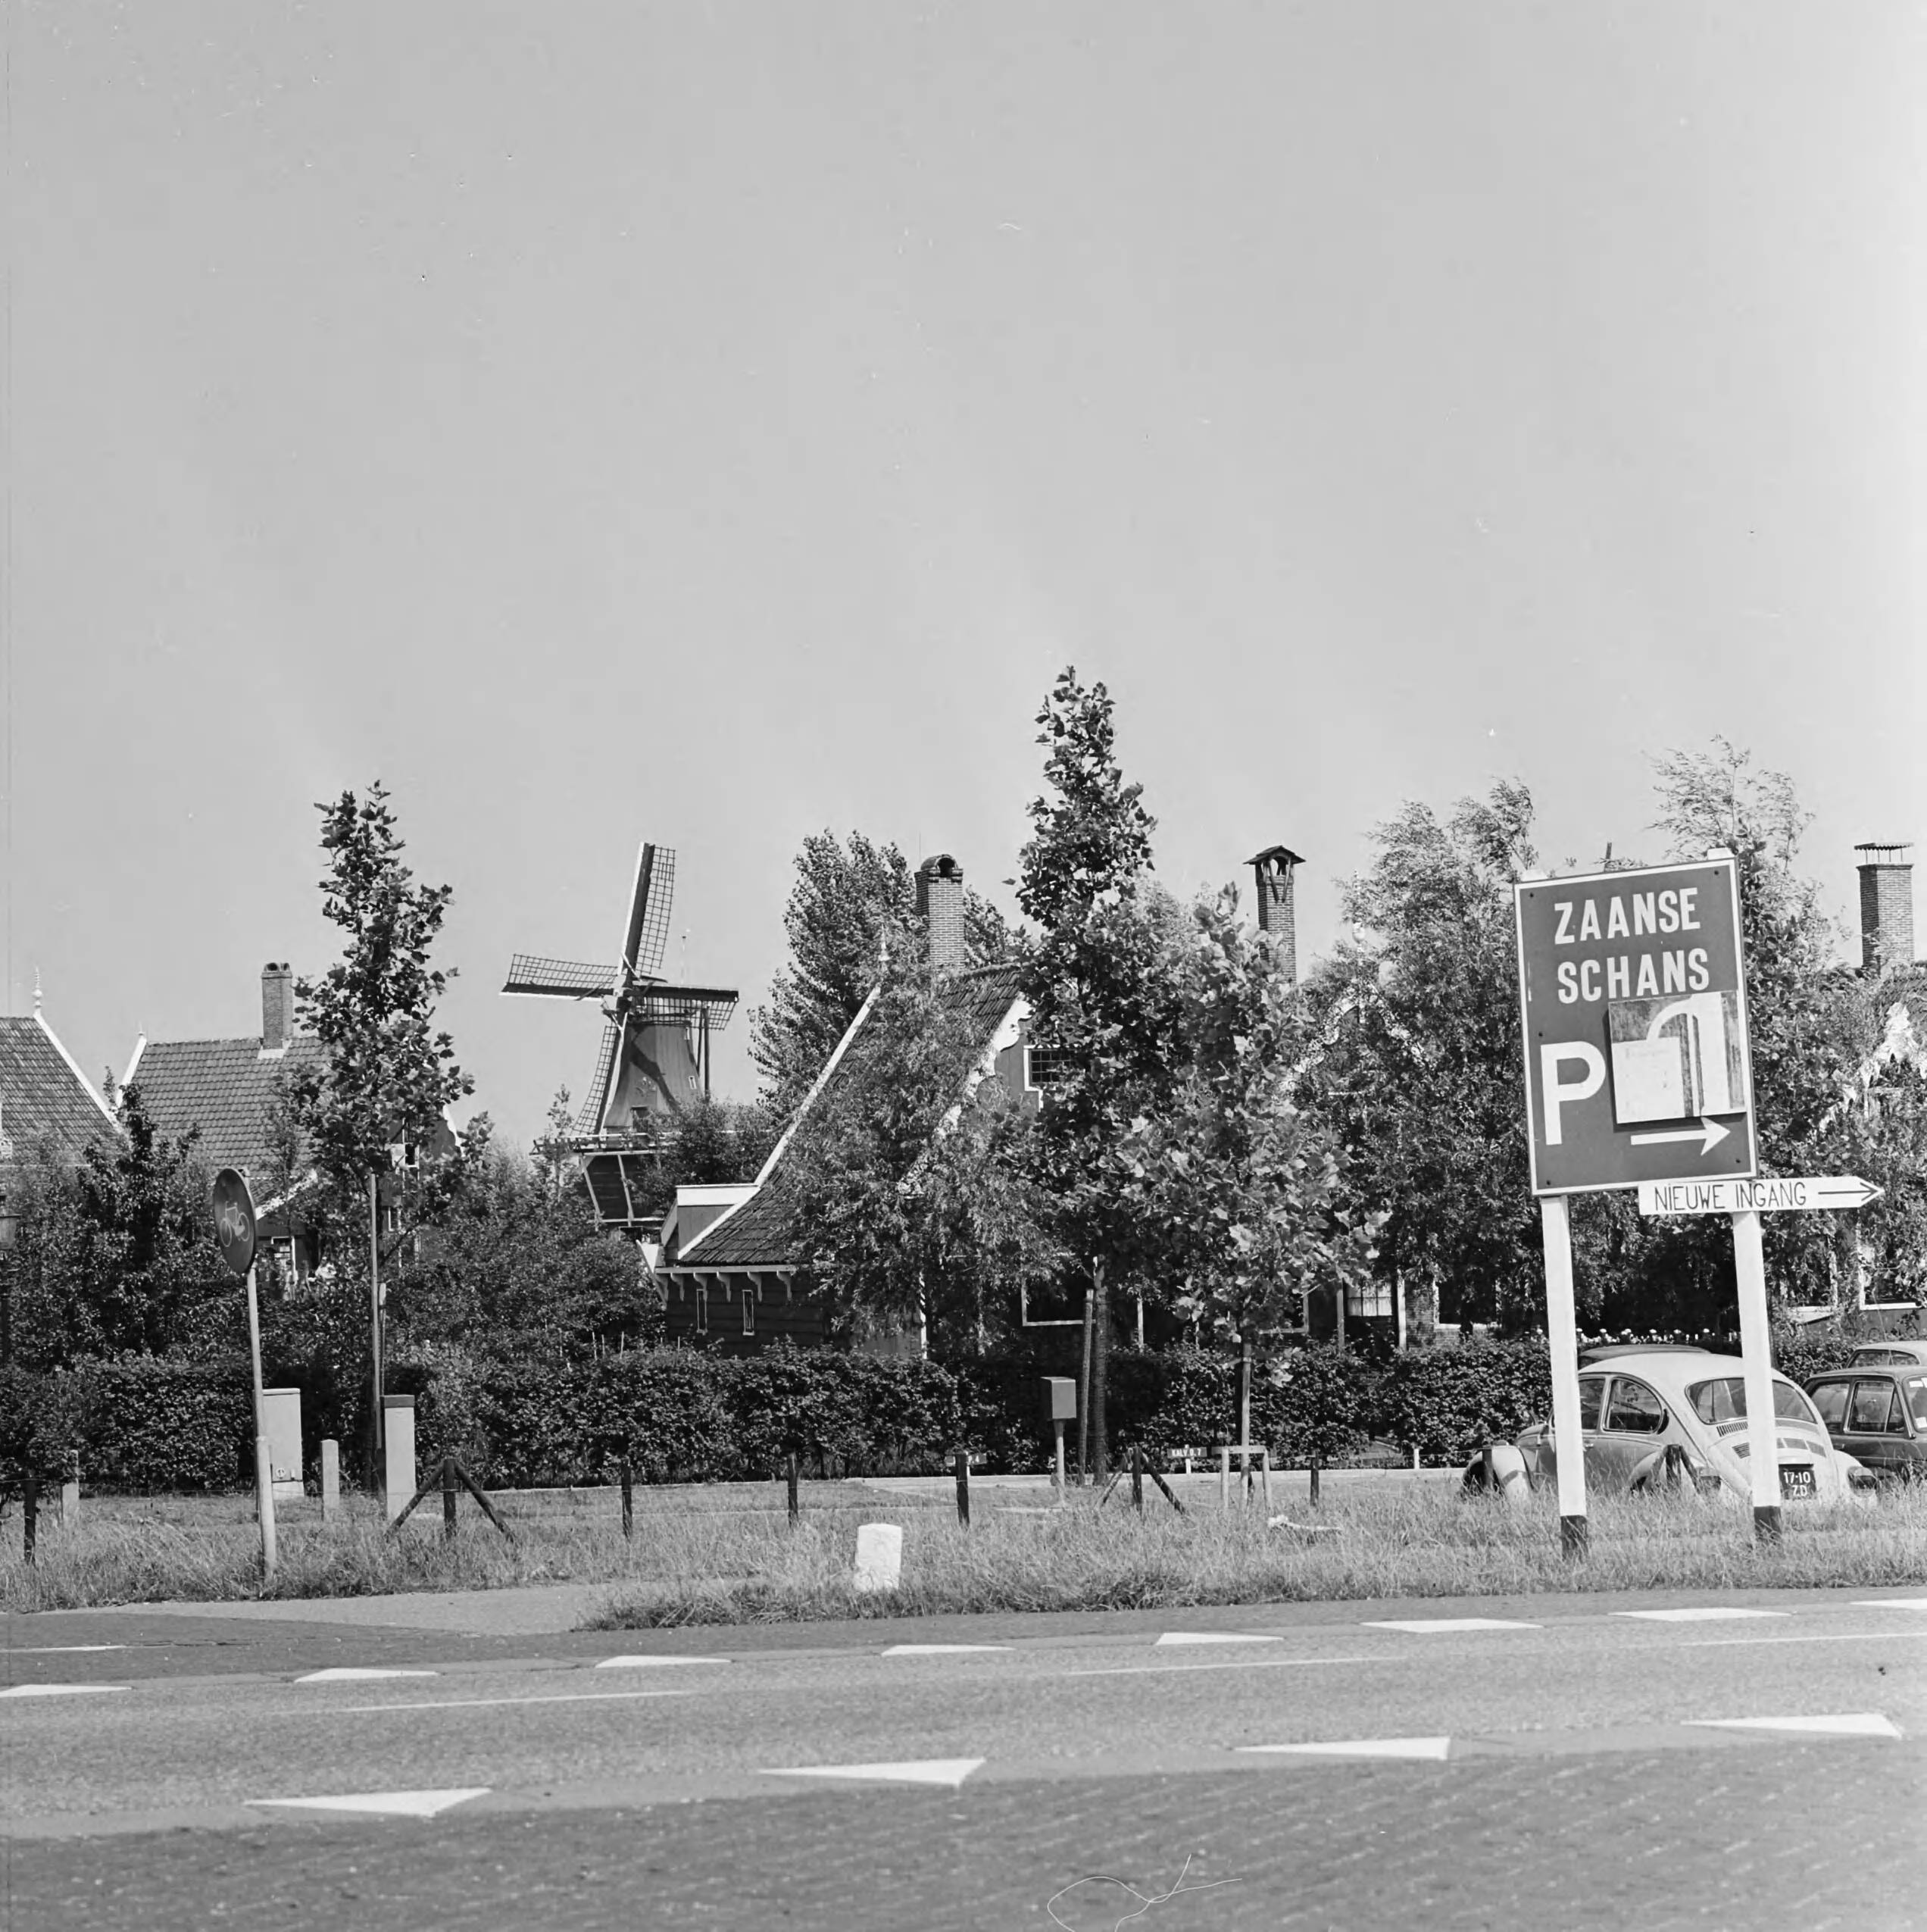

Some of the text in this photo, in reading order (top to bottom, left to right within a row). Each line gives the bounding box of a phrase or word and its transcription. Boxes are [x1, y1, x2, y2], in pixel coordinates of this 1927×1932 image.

[1554, 886, 1701, 945] ZAANSE
[1557, 948, 1710, 1005] SCHANS
[1540, 1041, 1607, 1146] P
[1654, 1181, 1807, 1211] NIEUWE INGANG
[1783, 1471, 1811, 1484] 17-10
